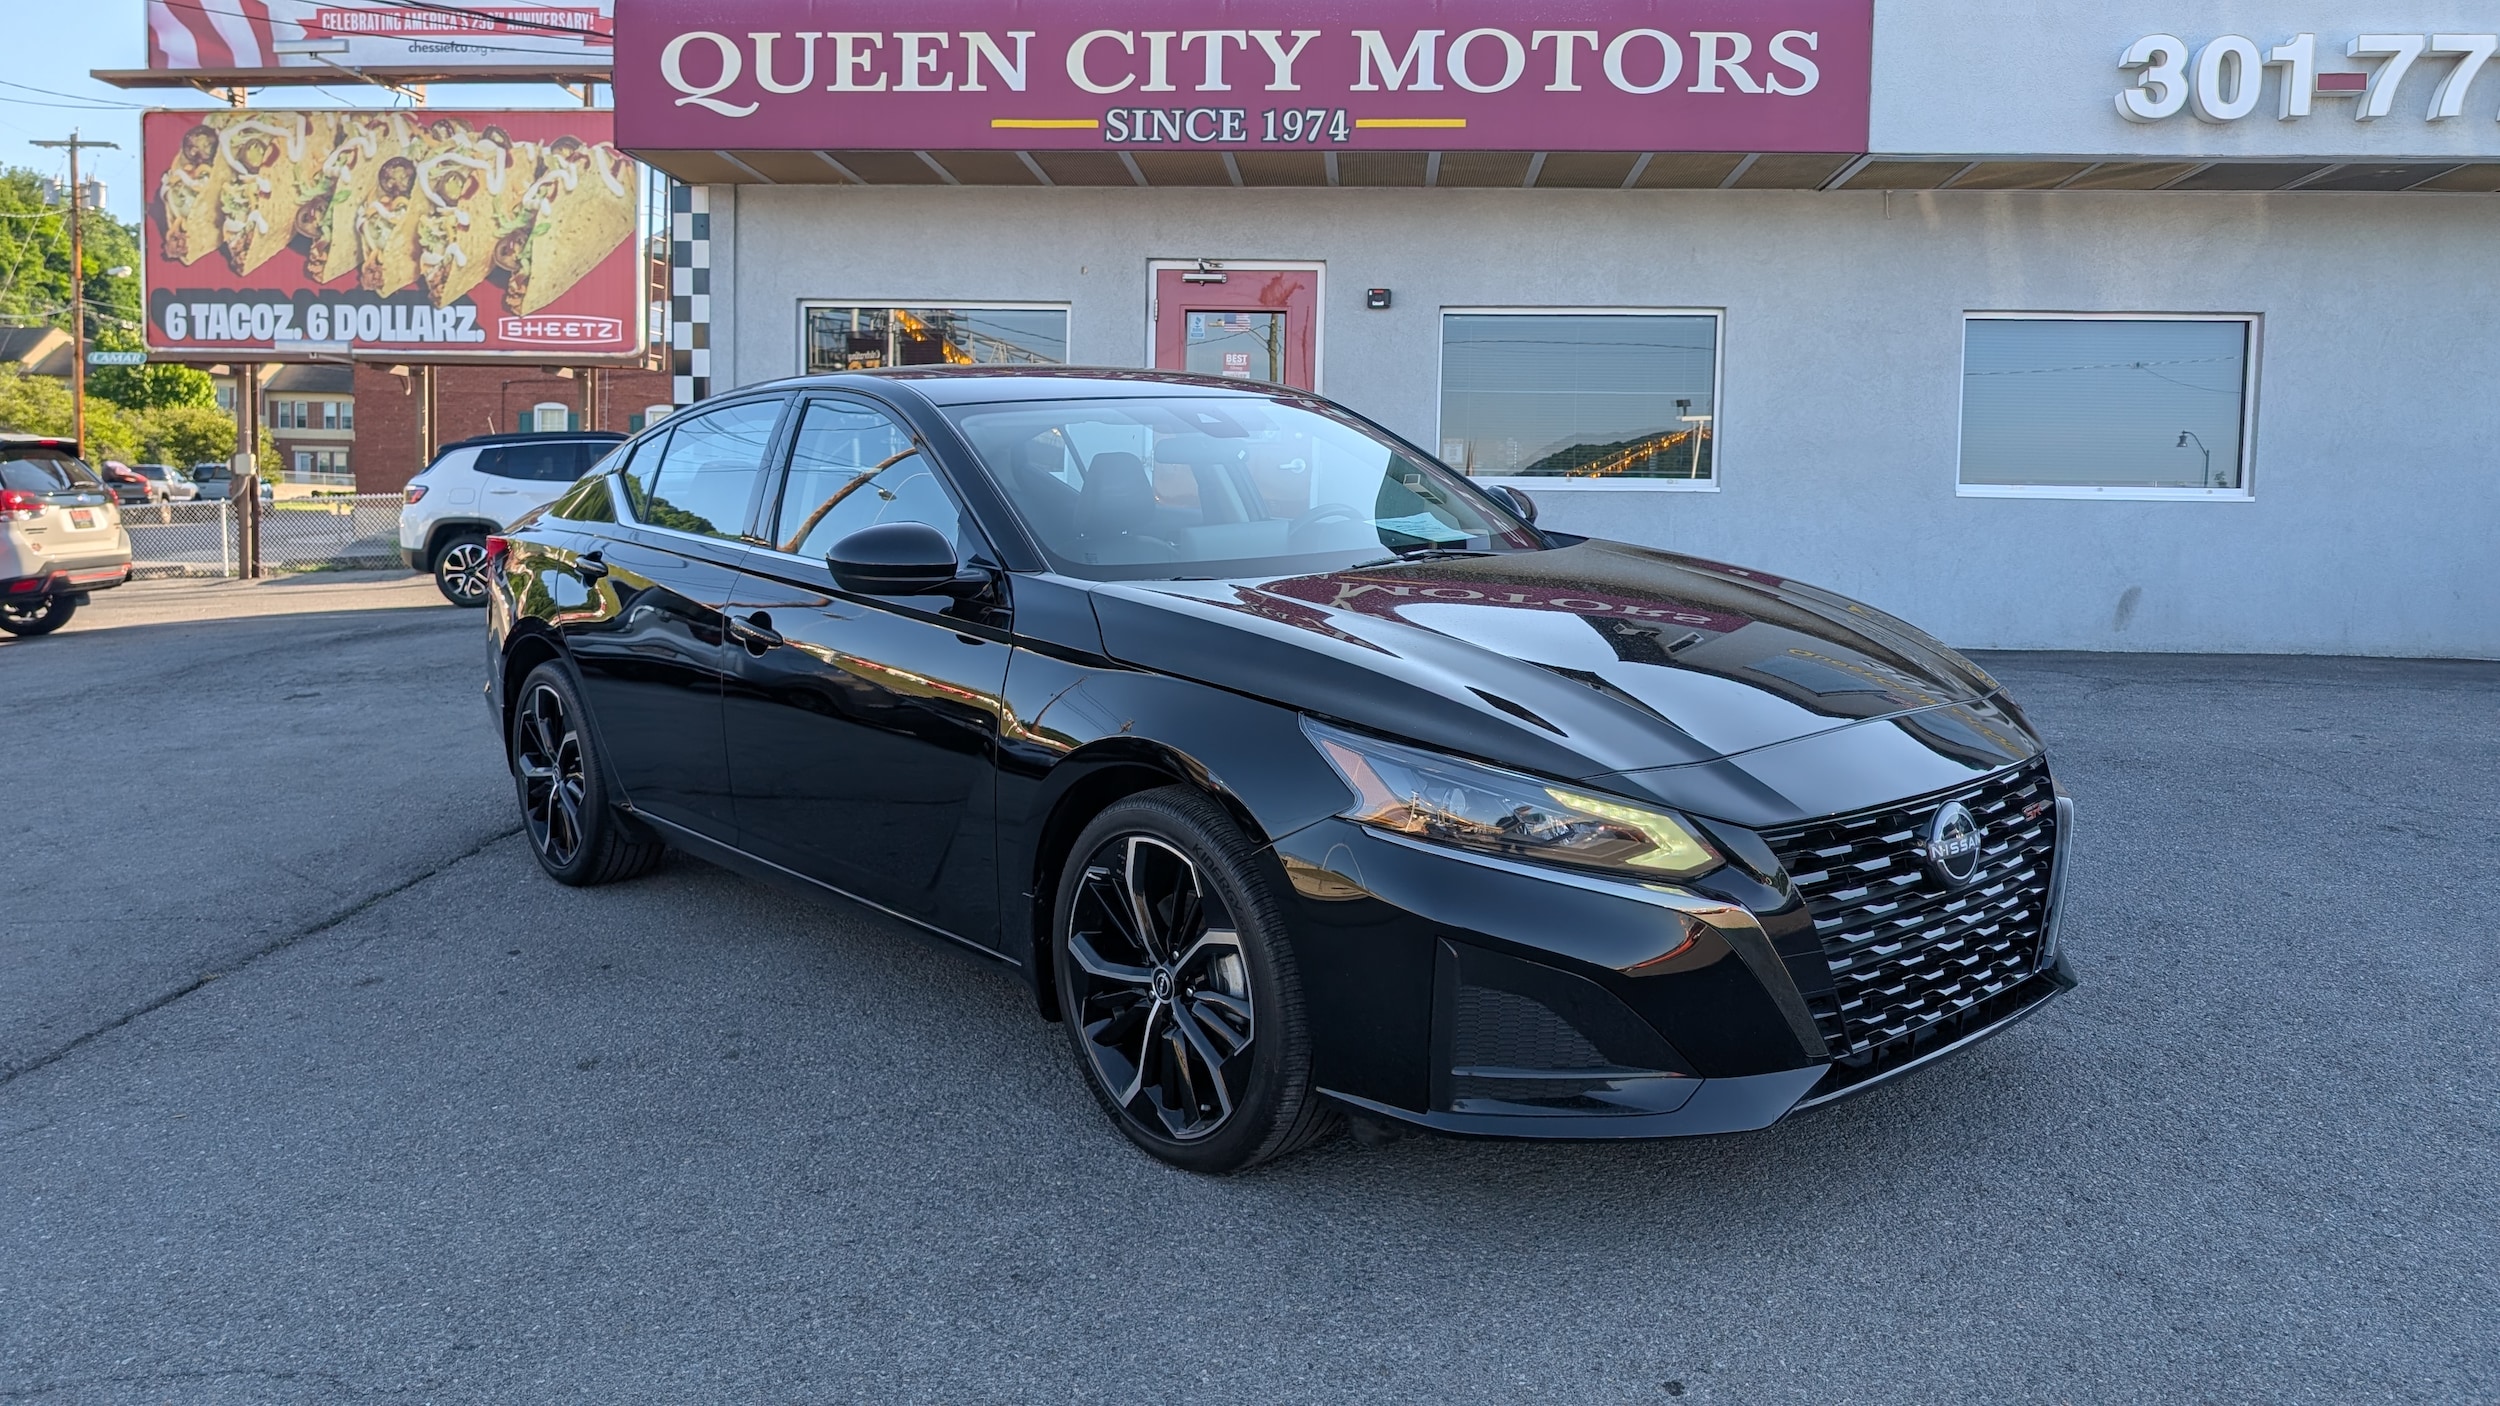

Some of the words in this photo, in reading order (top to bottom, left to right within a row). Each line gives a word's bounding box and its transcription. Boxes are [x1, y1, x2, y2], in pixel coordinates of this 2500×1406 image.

[322, 12, 402, 31] CELEBRATING
[404, 12, 468, 31] AMERICA'S
[506, 12, 594, 31] ANNIVERSARY!
[659, 30, 1037, 118] QUEEN
[1065, 29, 1322, 95] CITY
[1350, 28, 1821, 96] MOTORS
[2114, 33, 2500, 124] 301-77
[1104, 107, 1248, 143] SINCE
[1261, 108, 1350, 143] 1974
[165, 303, 188, 341] 6
[191, 303, 303, 341] TACOZ.
[306, 304, 330, 341] 6
[334, 304, 486, 343] DOLLARZ.
[507, 321, 614, 338] SHEETZ
[91, 353, 141, 363] LAMAR
[1225, 353, 1249, 363] BEST
[1931, 834, 1981, 860] NISSAN
[1192, 844, 1243, 912] KINERGY
